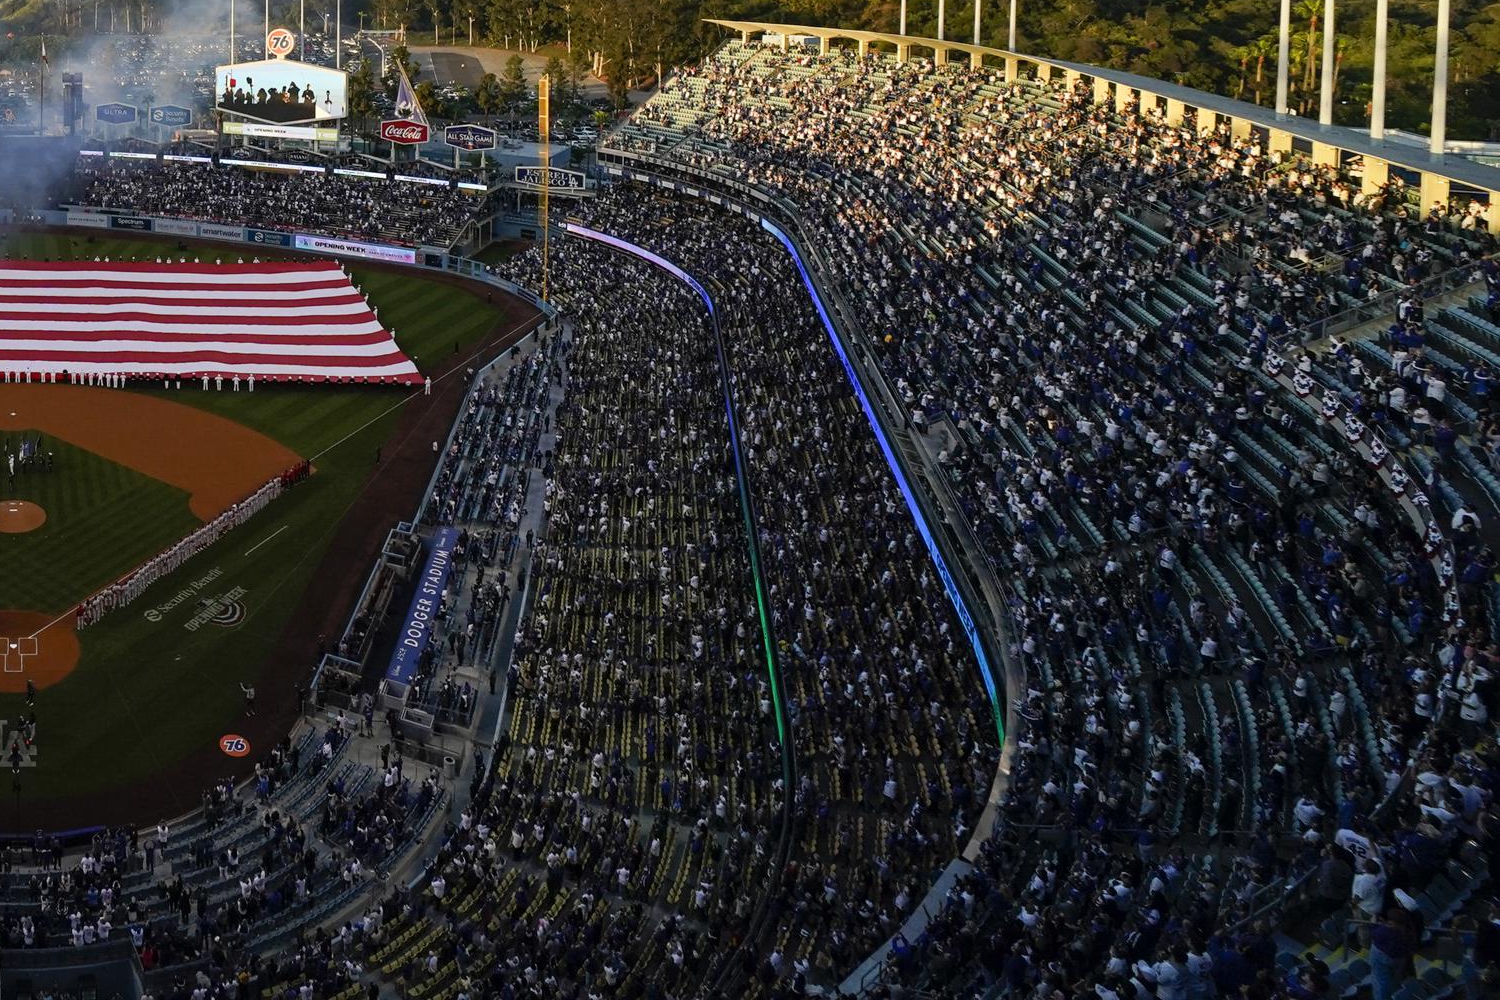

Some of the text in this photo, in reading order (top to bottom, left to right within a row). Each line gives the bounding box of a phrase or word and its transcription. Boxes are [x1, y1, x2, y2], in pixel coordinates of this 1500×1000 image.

[272, 35, 290, 49] 76
[474, 135, 493, 143] GAME
[117, 217, 145, 226] Spectrum
[202, 228, 241, 238] smartwater
[314, 241, 366, 253] OPENING WEEK
[404, 598, 433, 648] DODGER
[423, 550, 449, 595] STADIUM
[183, 585, 248, 632] OPENING WEEK
[224, 738, 247, 752] 76
